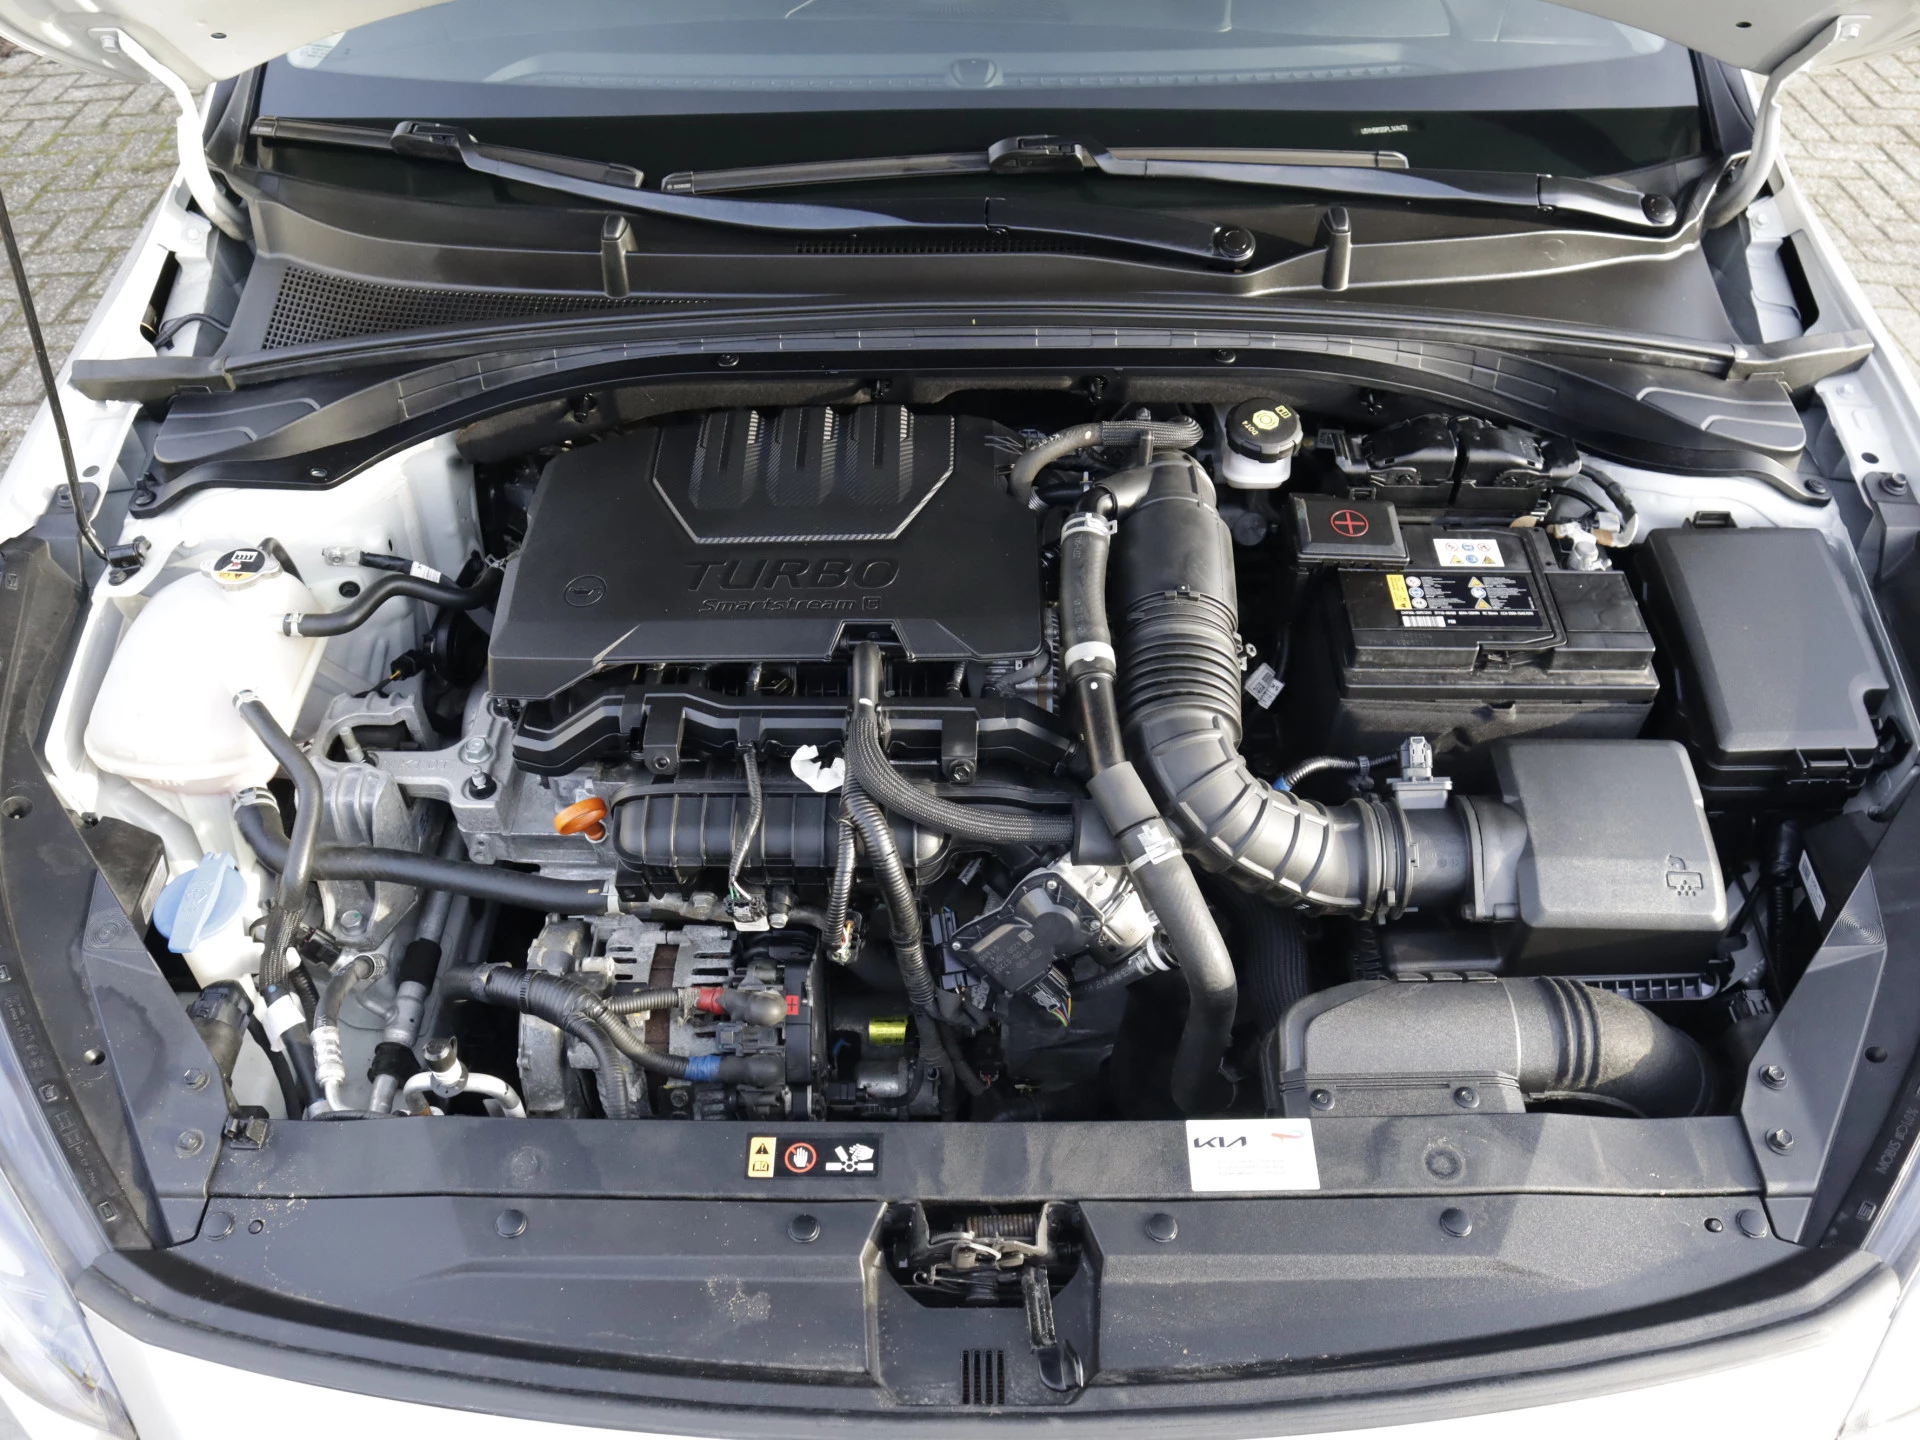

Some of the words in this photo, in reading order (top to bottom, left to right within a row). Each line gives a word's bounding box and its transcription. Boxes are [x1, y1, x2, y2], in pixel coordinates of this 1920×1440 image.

[685, 559, 900, 591] TURBO
[699, 598, 856, 612] Smartstream
[1193, 1136, 1247, 1148] KIA
[1876, 1139, 1901, 1174] MOBIS
